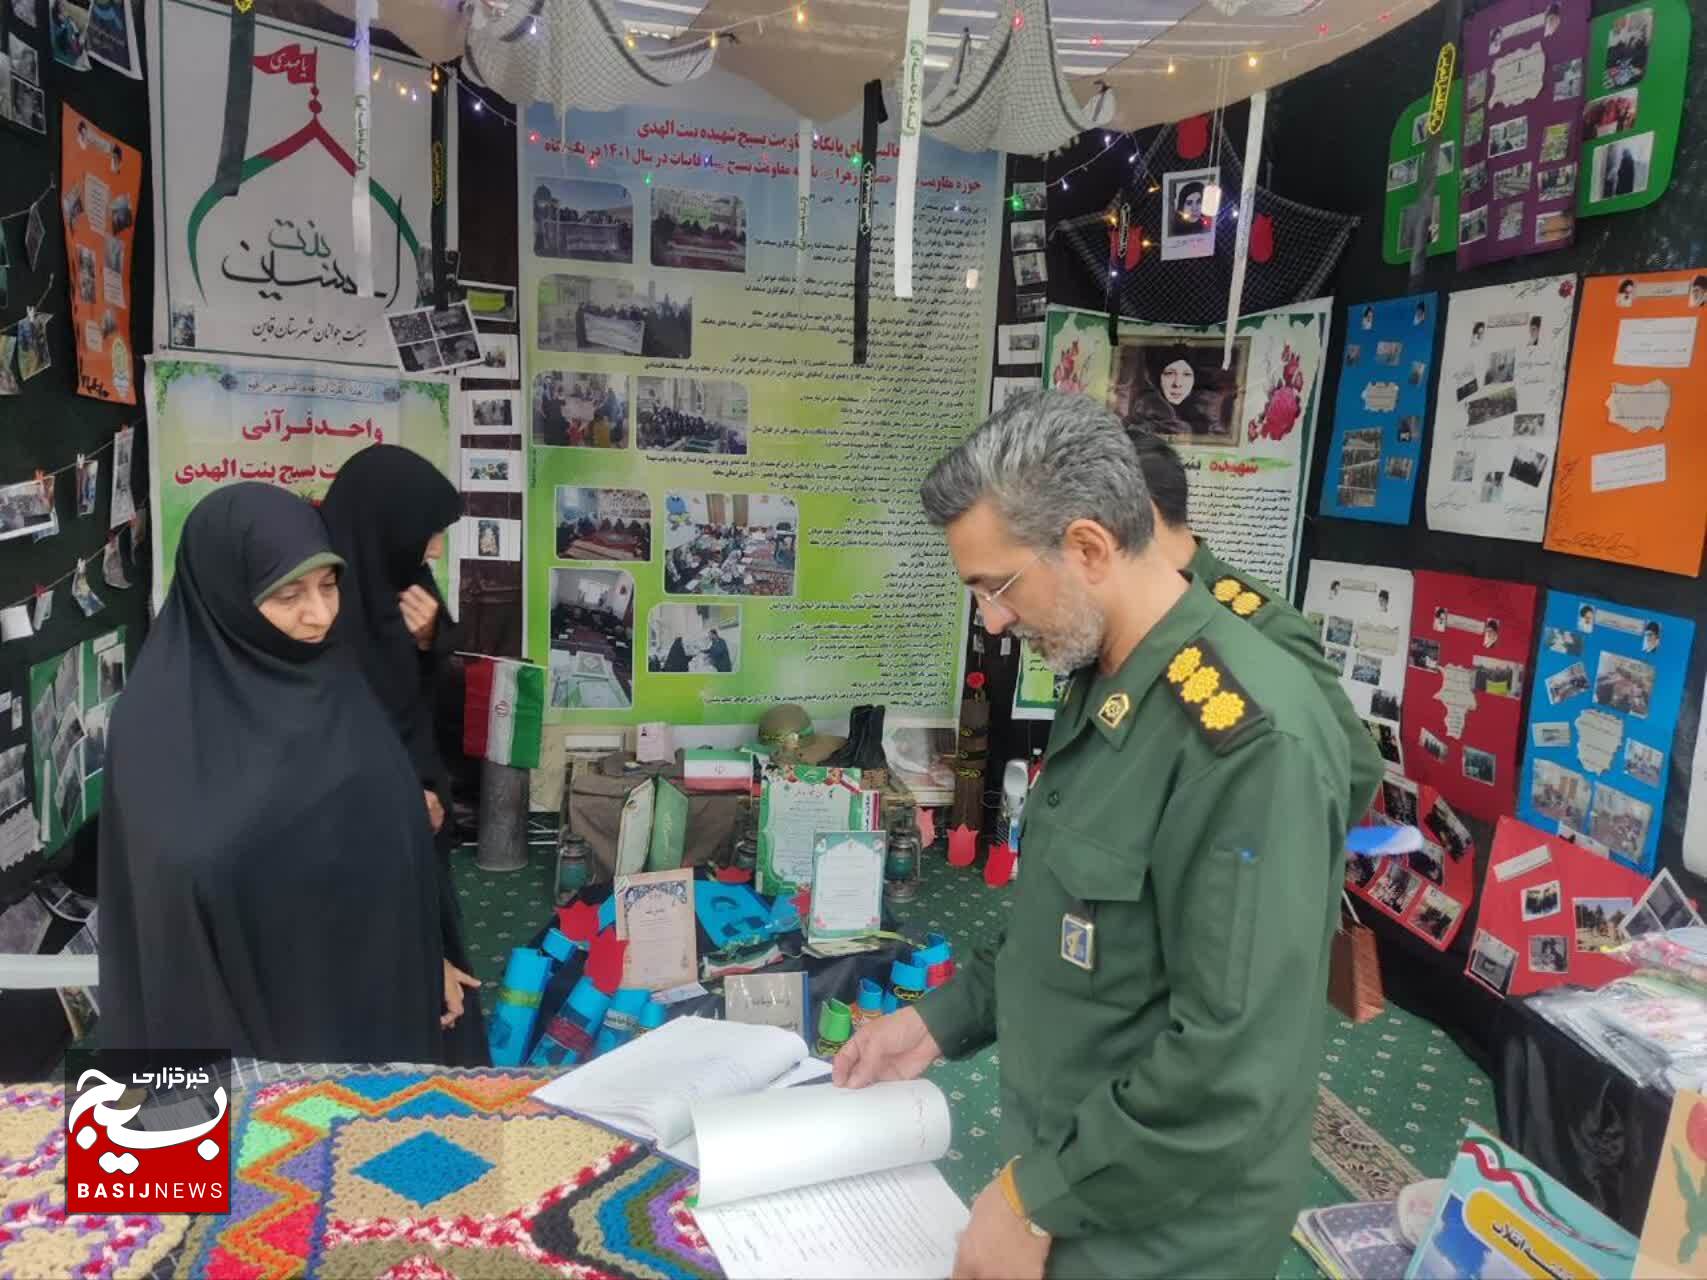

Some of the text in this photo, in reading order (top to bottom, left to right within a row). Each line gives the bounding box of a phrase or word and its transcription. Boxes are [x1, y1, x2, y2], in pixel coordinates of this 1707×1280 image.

[637, 120, 674, 139] الهدی
[241, 408, 384, 445] واحد قرآنی
[174, 456, 238, 485] الهدی
[239, 460, 276, 484] بنت
[279, 461, 317, 485] بسیج
